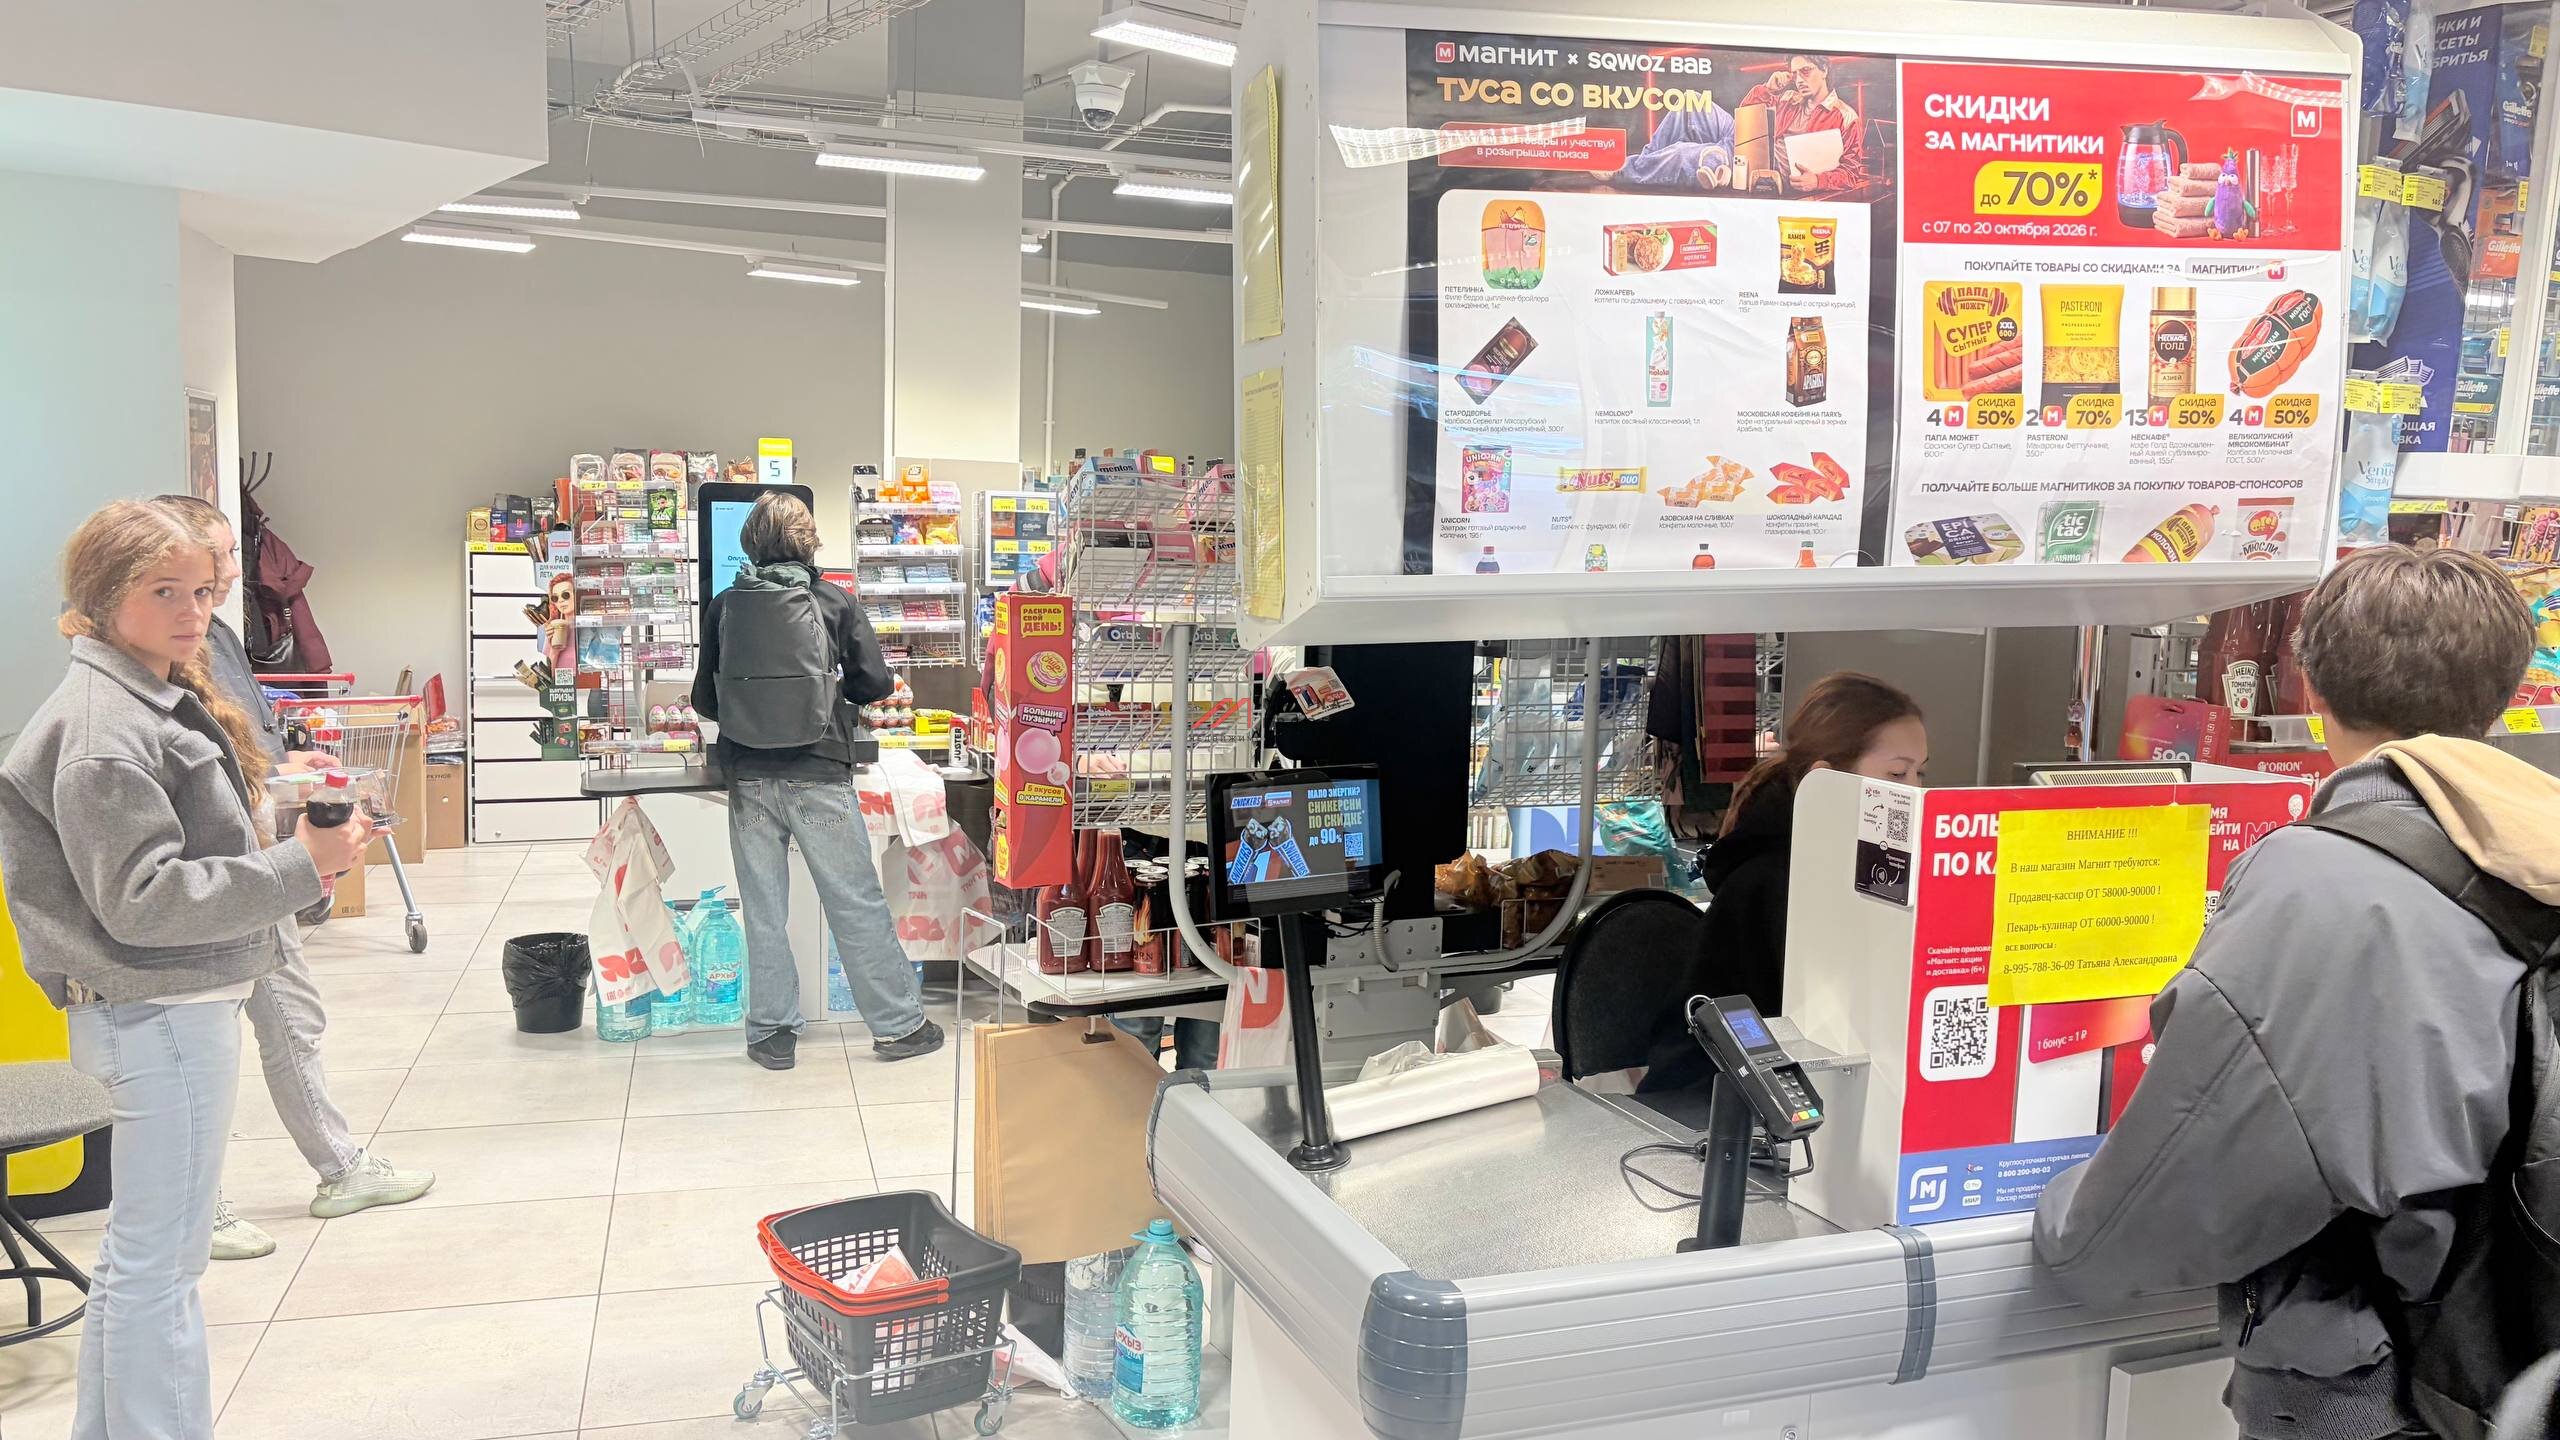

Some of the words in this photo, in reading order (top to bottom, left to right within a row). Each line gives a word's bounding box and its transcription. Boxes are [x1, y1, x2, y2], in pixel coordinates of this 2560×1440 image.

[1587, 52, 1665, 72] SQWOZ
[2432, 49, 2489, 69] БРИТЬЯ
[1529, 82, 1575, 107] СО
[1582, 84, 1713, 113] ВКУСОМ
[1924, 94, 2050, 123] СКИДКИ
[2502, 100, 2533, 119] Gillette
[1569, 138, 1615, 150] участвуй
[1924, 132, 1954, 151] ЗА
[1960, 133, 2105, 156] МАГНИТИКИ
[1477, 147, 1483, 156] в
[1485, 147, 1547, 160] розыгрышах
[1549, 150, 1590, 160] призов
[1980, 193, 2001, 208] до
[1922, 226, 1931, 234] с
[1933, 222, 1950, 235] 07
[1953, 225, 1969, 236] по
[1970, 222, 1989, 235] 20
[1991, 223, 2050, 238] октября
[2052, 223, 2087, 237] 2026
[2089, 227, 2098, 237] г.
[2488, 240, 2521, 253] Gillette
[1964, 260, 2033, 272] ПОКУПАЙТЕ
[2035, 262, 2081, 273] ТОВАРЫ
[2083, 263, 2098, 273] СО
[1445, 286, 1485, 294] ПЕТЕЛИНКА
[1594, 289, 1635, 297] ЛОЖКАРЕВЪ
[1739, 291, 1759, 299] REENA
[1957, 287, 1989, 298] ПАПА
[1959, 301, 1986, 311] МОЖЕТ
[2060, 300, 2103, 313] PASTERONI
[1946, 320, 1993, 344] СУПЕР
[1999, 322, 2015, 330] XXL
[1953, 336, 1988, 353] СЫТНЫЕ
[2160, 342, 2185, 351] ГОЛД
[2457, 380, 2488, 393] Gillette
[1781, 410, 1810, 418] КОФЕЙНЯ
[1926, 409, 1942, 427] 4
[1976, 410, 2016, 426] 50%
[2026, 409, 2039, 427] 2
[2076, 410, 2112, 426] 70%
[2124, 409, 2148, 427] 13
[2178, 410, 2215, 425] 50%
[2228, 409, 2243, 426] 4
[2273, 410, 2311, 425] 50%
[1925, 434, 1948, 442] ПАПА
[2027, 434, 2069, 442] PASTERONI
[2228, 432, 2294, 441] ВЕЛИКОЛУКСКИЙ
[1099, 465, 1133, 473] mentos
[1619, 474, 1639, 486] DUO
[1921, 481, 1990, 493] ПОЛУЧАЙТЕ
[1991, 482, 2038, 493] БОЛЬШЕ
[2040, 482, 2115, 492] МАГНИТИКОВ
[2117, 481, 2131, 491] ЗА
[2133, 480, 2186, 491] ПОКУПКУ
[2188, 479, 2304, 490] ТОВАРОВ-СПОНСОРОВ
[1660, 514, 1694, 522] АЗОВСКАЯ
[1694, 514, 1703, 522] НА
[1704, 514, 1734, 522] СЛИВКАХ
[1766, 513, 1813, 522] ШОКОЛАДНЫЙ
[2063, 513, 2085, 527] tic
[1941, 520, 1969, 531] EPI
[2056, 525, 2084, 538] tac
[1945, 528, 1974, 539] CA
[2242, 540, 2279, 556] МЮСЛИ
[1022, 607, 1062, 616] РАСКРАСЬ
[1022, 614, 1043, 622] СВОЙ
[1022, 620, 1063, 634] ДЕНЬ!
[1111, 629, 1141, 641] Orbit
[2235, 667, 2256, 677] HEINZ
[549, 692, 575, 702] ПРИЗЫ
[1023, 706, 1064, 720] БОЛЬШИЕ
[1022, 714, 1056, 726] ПУЗЫРИ
[2266, 761, 2301, 772] ORION
[1307, 789, 1327, 799] МАЛО
[1328, 786, 1361, 798] ЭНЕРГИИ?
[1026, 795, 1062, 804] КАРАМЕЛИ
[1231, 796, 1263, 809] SNICKERS
[1307, 798, 1362, 814] СНИКЕРСНИ
[1308, 815, 1322, 829] ПО
[1308, 835, 1319, 847] ДО
[1320, 828, 1343, 845] 90%
[2066, 828, 2126, 841] ВНИМАНИЕ
[2127, 827, 2138, 838] !!!
[2223, 839, 2240, 851] НА
[1231, 843, 1252, 883] SNICKERS
[1283, 839, 1310, 877] SNICKERS
[1932, 851, 1970, 877] ПО
[1976, 851, 1998, 876] К
[2010, 863, 2018, 873] В
[2019, 863, 2039, 873] наш
[2040, 862, 2076, 873] магазин
[2078, 859, 2111, 870] Магнит
[2113, 858, 2161, 871] требуются:
[2008, 890, 2084, 905] Продавец-кассир
[2086, 888, 2100, 899] ОТ
[2101, 885, 2156, 898] 58000-90000
[2006, 920, 2077, 934] Пекарь-кулинар
[2079, 917, 2094, 929] ОТ
[2095, 914, 2150, 928] 60000-90000
[1927, 945, 1960, 956] Скачайте
[1960, 955, 1983, 964] акции
[2003, 959, 2075, 975] 8-995-788-36-09
[2076, 957, 2111, 970] Татьяна
[2113, 953, 2178, 968] Александровна
[709, 971, 737, 980] АРХЫЗ
[1970, 964, 1986, 975] (6+)
[2043, 1036, 2067, 1050] бонус
